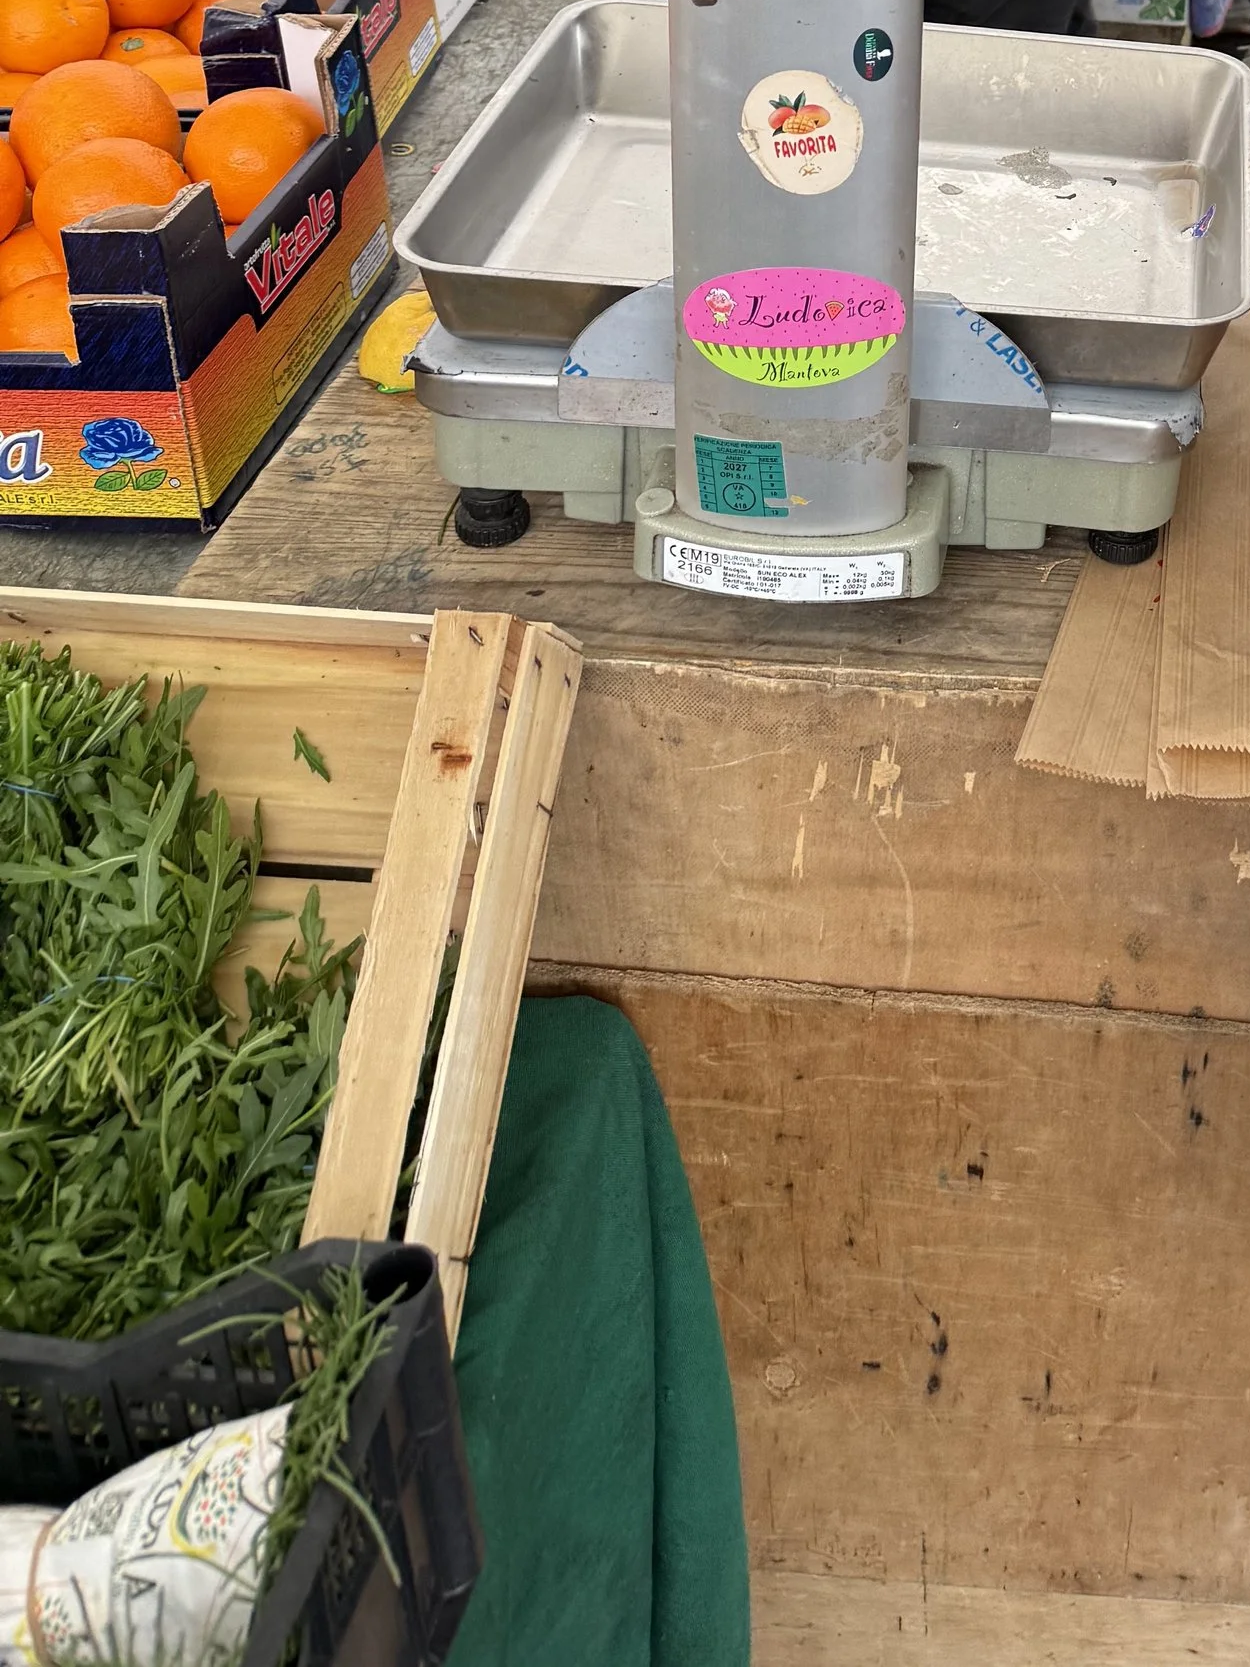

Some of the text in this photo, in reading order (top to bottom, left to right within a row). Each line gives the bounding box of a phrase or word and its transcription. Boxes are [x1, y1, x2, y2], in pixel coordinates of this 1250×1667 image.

[774, 135, 837, 158] FAVORITA
[243, 187, 340, 303] Vitale
[985, 333, 1042, 394] LASE
[724, 462, 747, 472] 2027
[677, 560, 713, 576] 2166
